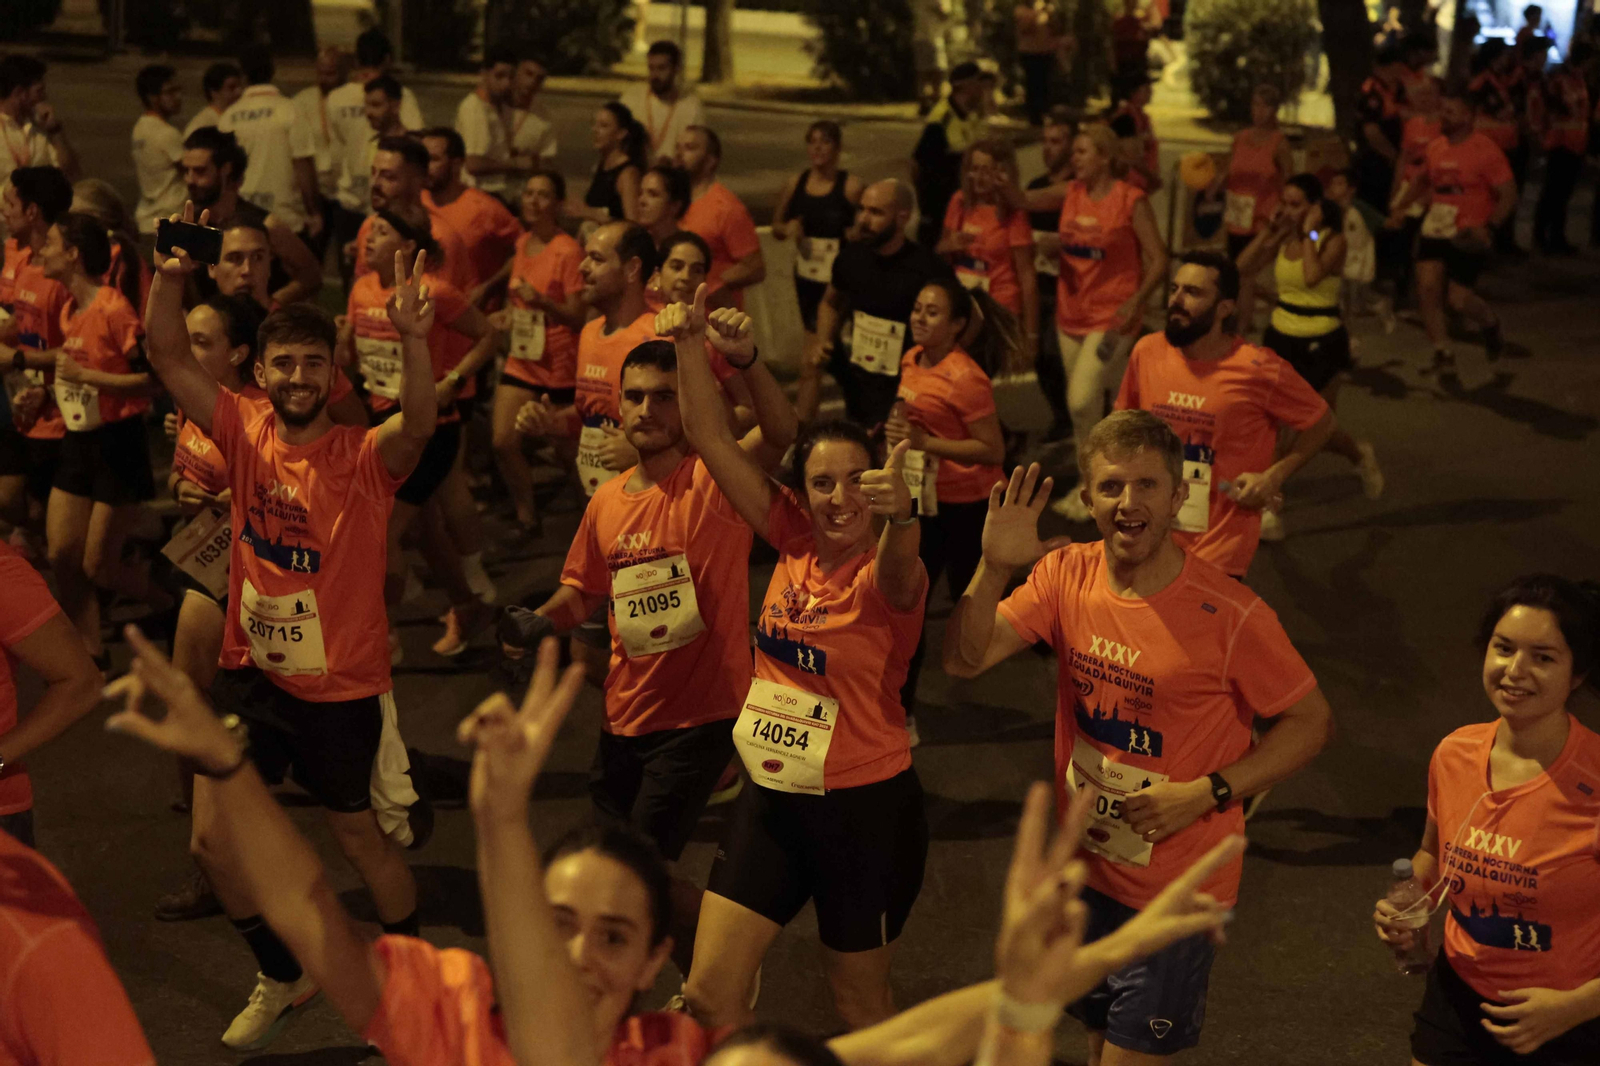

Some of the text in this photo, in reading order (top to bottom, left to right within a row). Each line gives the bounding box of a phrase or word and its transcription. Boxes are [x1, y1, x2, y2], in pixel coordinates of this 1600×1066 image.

[1167, 391, 1206, 409] XXXV
[628, 590, 681, 618] 21095
[248, 617, 303, 642] 20715
[1089, 634, 1141, 668] XXXV
[1073, 661, 1153, 697] GUADALQUIVIR
[1108, 663, 1155, 686] NOCTURNA
[752, 718, 809, 751] 14054
[764, 761, 780, 771] KH7
[1464, 826, 1522, 858] XXXV
[1483, 857, 1539, 876] NOCTURNA
